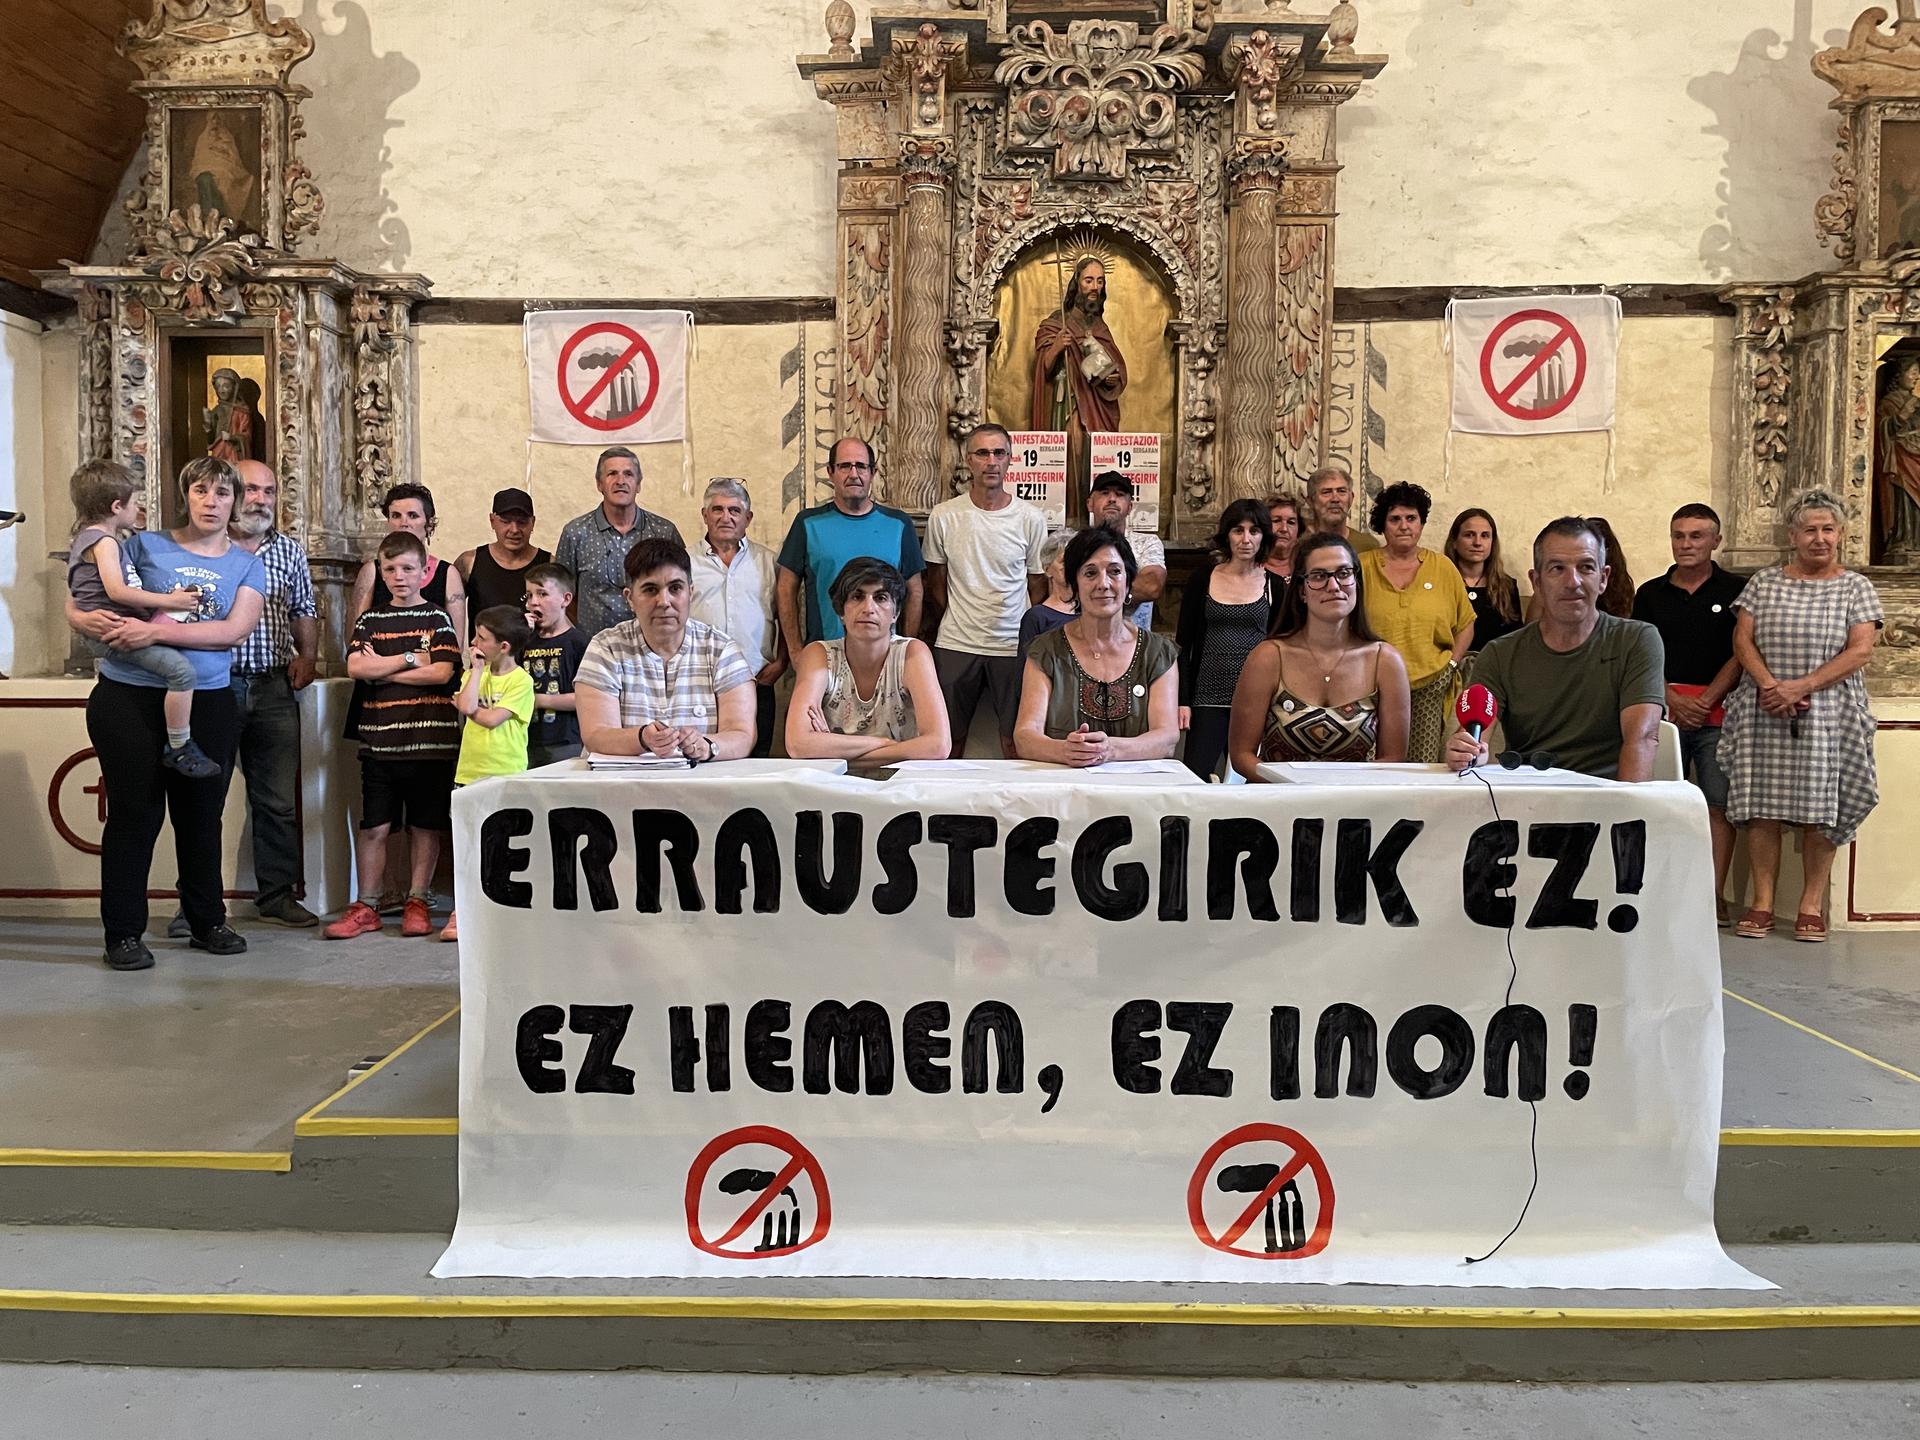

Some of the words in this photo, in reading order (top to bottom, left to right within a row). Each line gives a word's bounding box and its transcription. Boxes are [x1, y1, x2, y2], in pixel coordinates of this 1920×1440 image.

[1093, 435, 1159, 446] MANIFESTAZIOA
[1023, 449, 1038, 467] 19
[1116, 450, 1132, 468] 19
[1003, 472, 1065, 483] RRAUSTEGIRIK
[1016, 483, 1047, 501] EZ!!!
[480, 806, 1425, 928] ERRAUSTEGIRIK
[1463, 818, 1647, 934] EZ!
[515, 1003, 636, 1095] EZ
[668, 999, 1064, 1114] HEMEN,
[1110, 999, 1234, 1098] EZ
[1269, 1002, 1598, 1101] INON!
